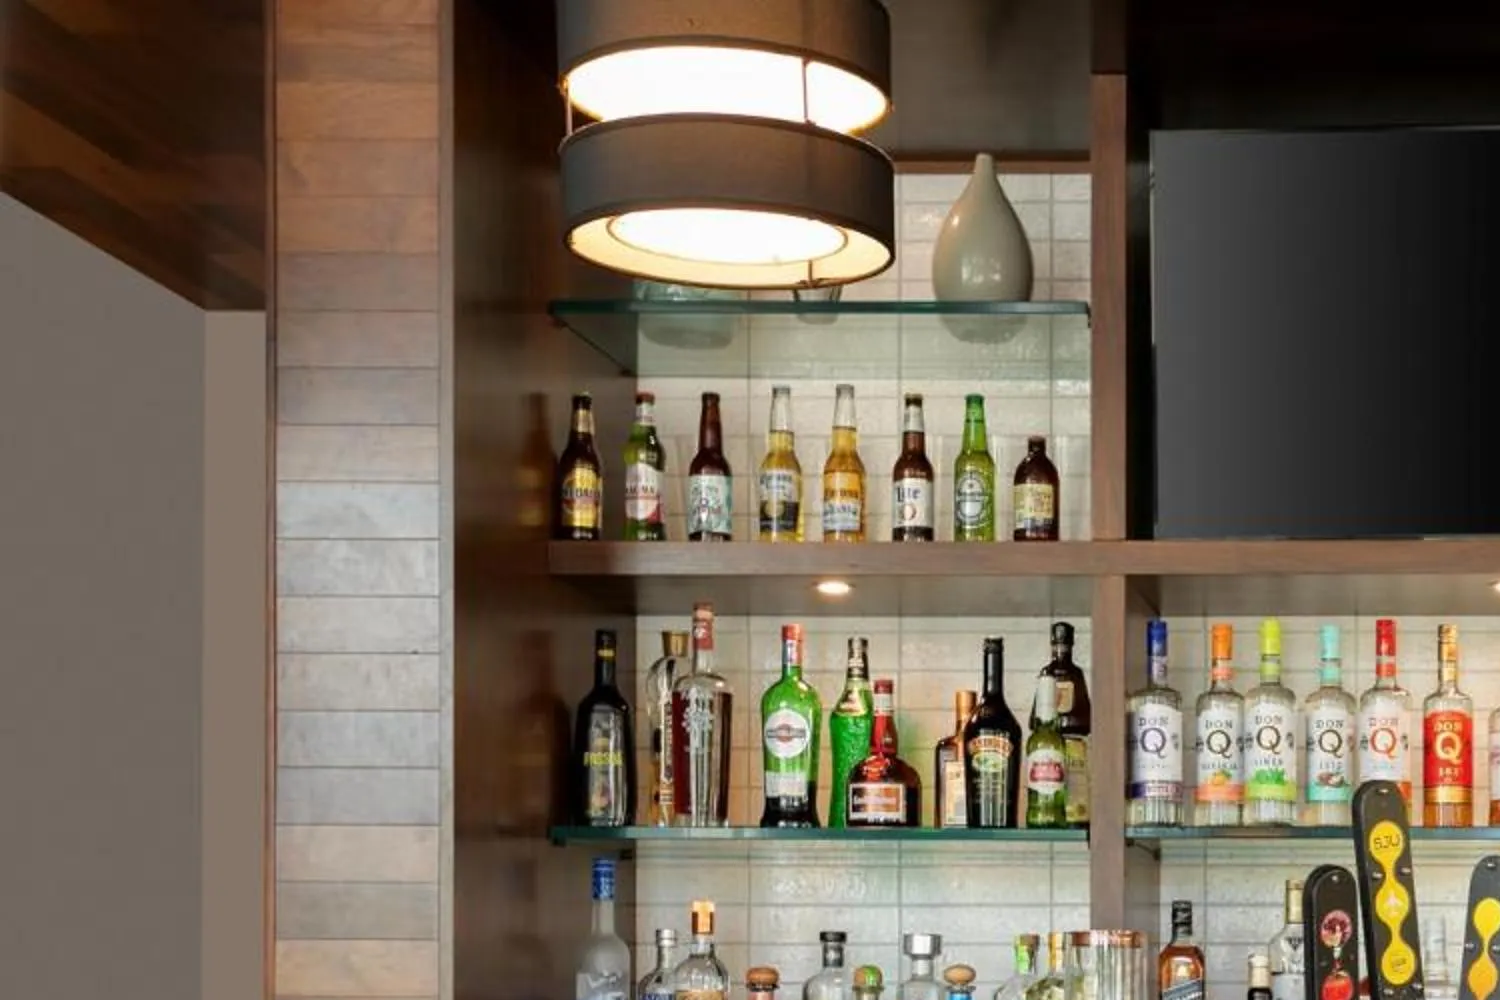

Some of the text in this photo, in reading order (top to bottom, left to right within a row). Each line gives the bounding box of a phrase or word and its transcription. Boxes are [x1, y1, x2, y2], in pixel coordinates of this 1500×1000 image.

[896, 486, 922, 502] Lite
[1138, 717, 1169, 727] DON
[1205, 719, 1233, 729] DON
[1255, 715, 1283, 725] DON
[1316, 719, 1344, 729] DON
[1141, 727, 1168, 760] Q
[1206, 729, 1233, 759] Q
[1257, 725, 1282, 755] Q
[1318, 729, 1344, 759] Q
[1370, 727, 1397, 760] Q
[1435, 730, 1463, 767] Q
[1373, 835, 1400, 851] SJU
